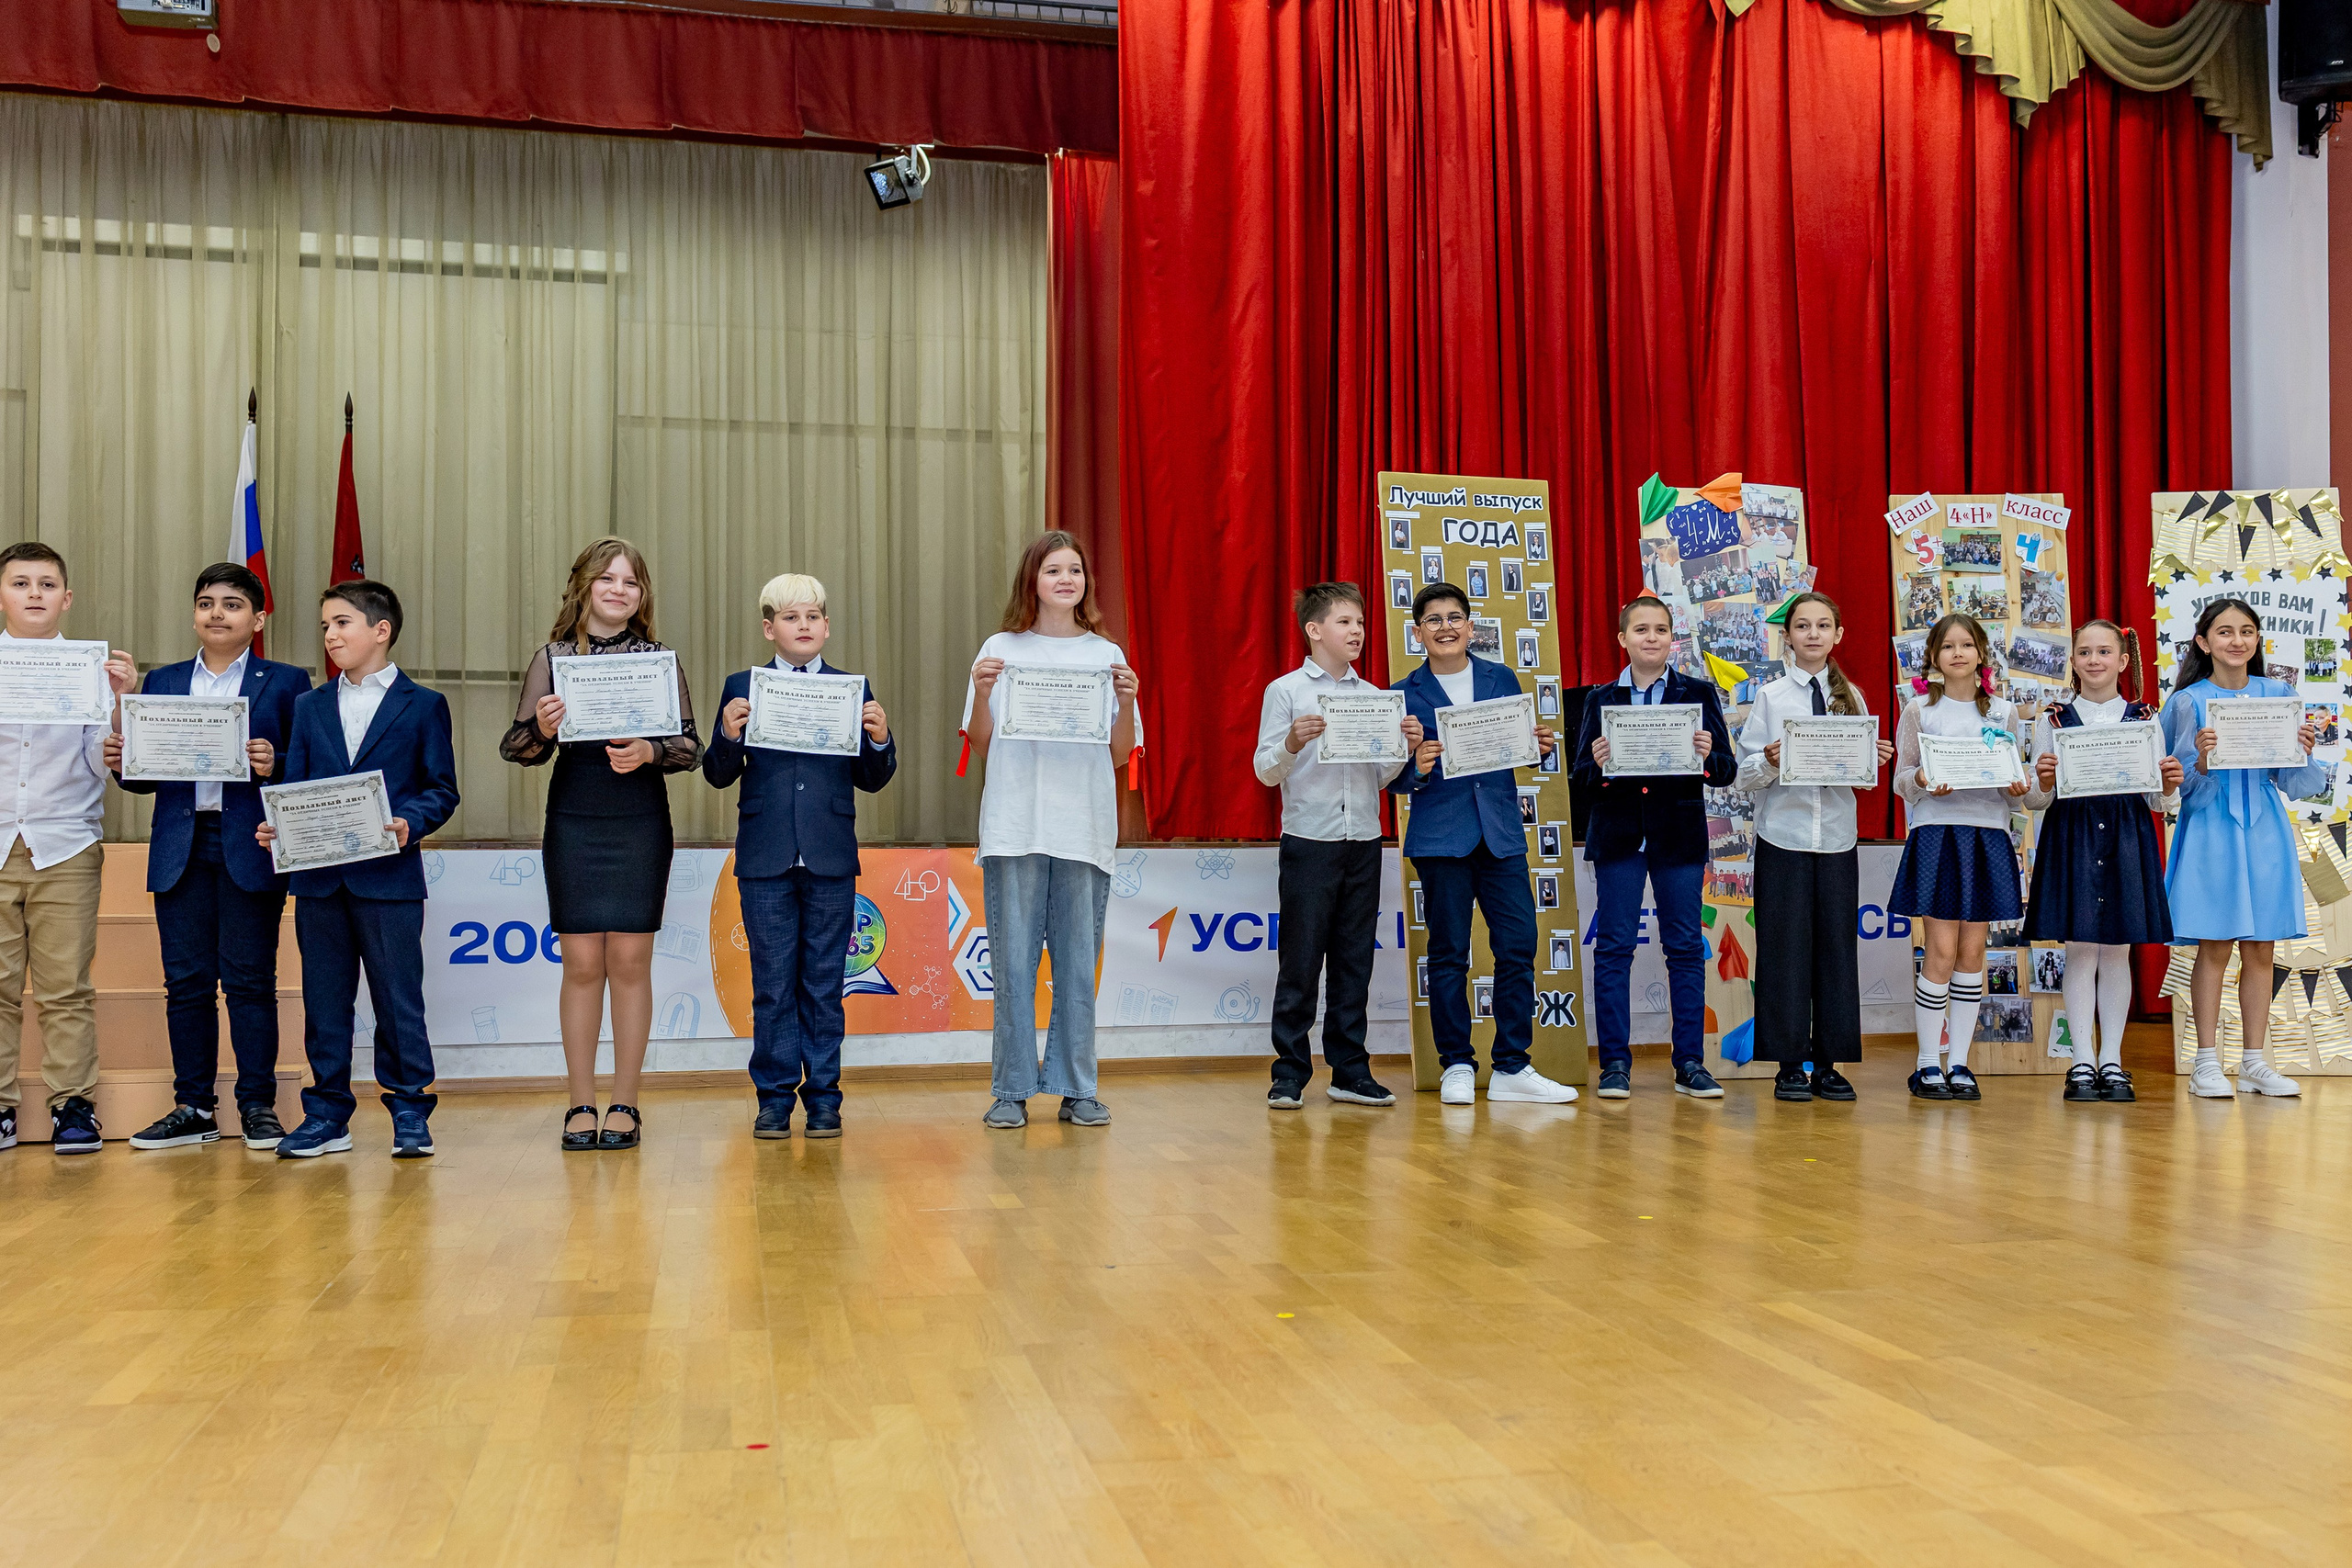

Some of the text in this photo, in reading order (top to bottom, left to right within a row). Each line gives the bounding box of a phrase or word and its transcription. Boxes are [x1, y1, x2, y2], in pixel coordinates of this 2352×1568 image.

[1389, 486, 1543, 513] Лучший выпуск
[1889, 499, 1933, 529] Наш
[2005, 500, 2064, 525] класс
[1443, 519, 1519, 548] ГОДА
[2278, 593, 2313, 615] ВАМ
[1539, 992, 1576, 1026] Ж
